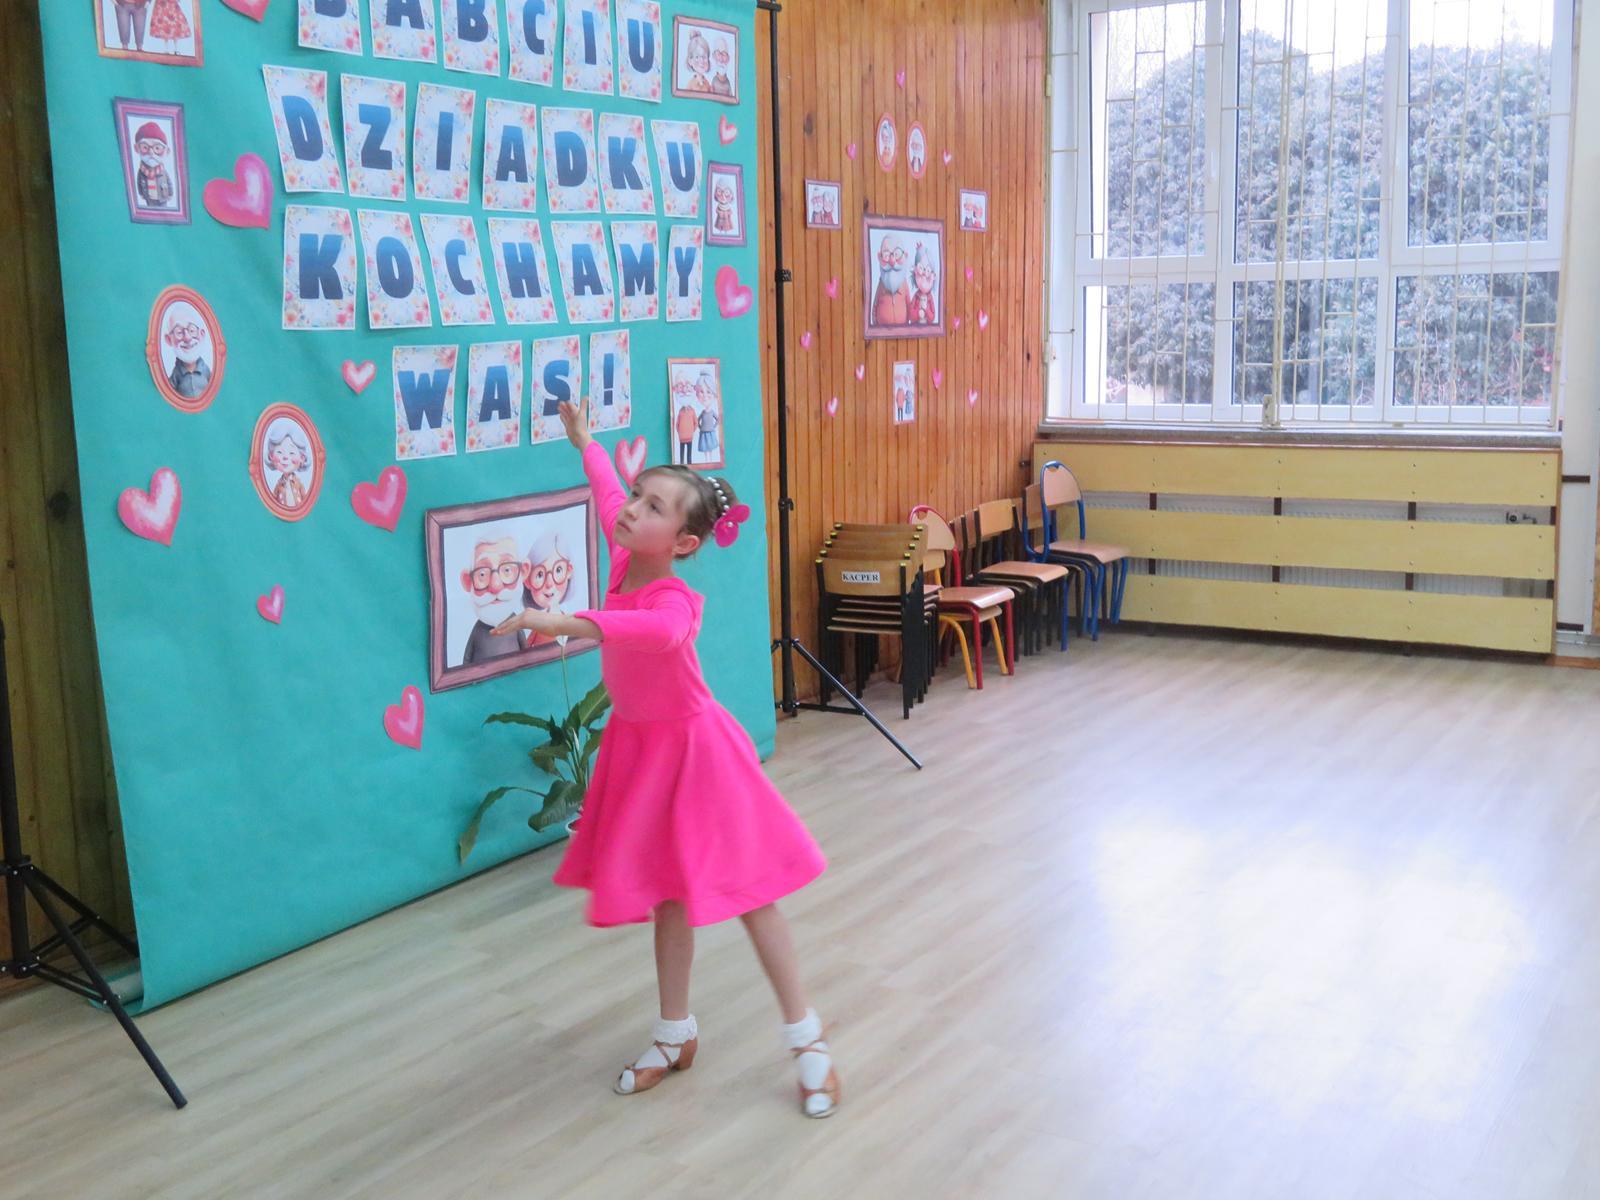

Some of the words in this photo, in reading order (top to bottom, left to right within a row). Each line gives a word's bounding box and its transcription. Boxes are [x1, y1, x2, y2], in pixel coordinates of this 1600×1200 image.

[281, 96, 696, 192] DZIADKU
[299, 233, 697, 300] KOCHAMY
[396, 353, 614, 431] WAS!
[842, 573, 879, 581] KACPER
